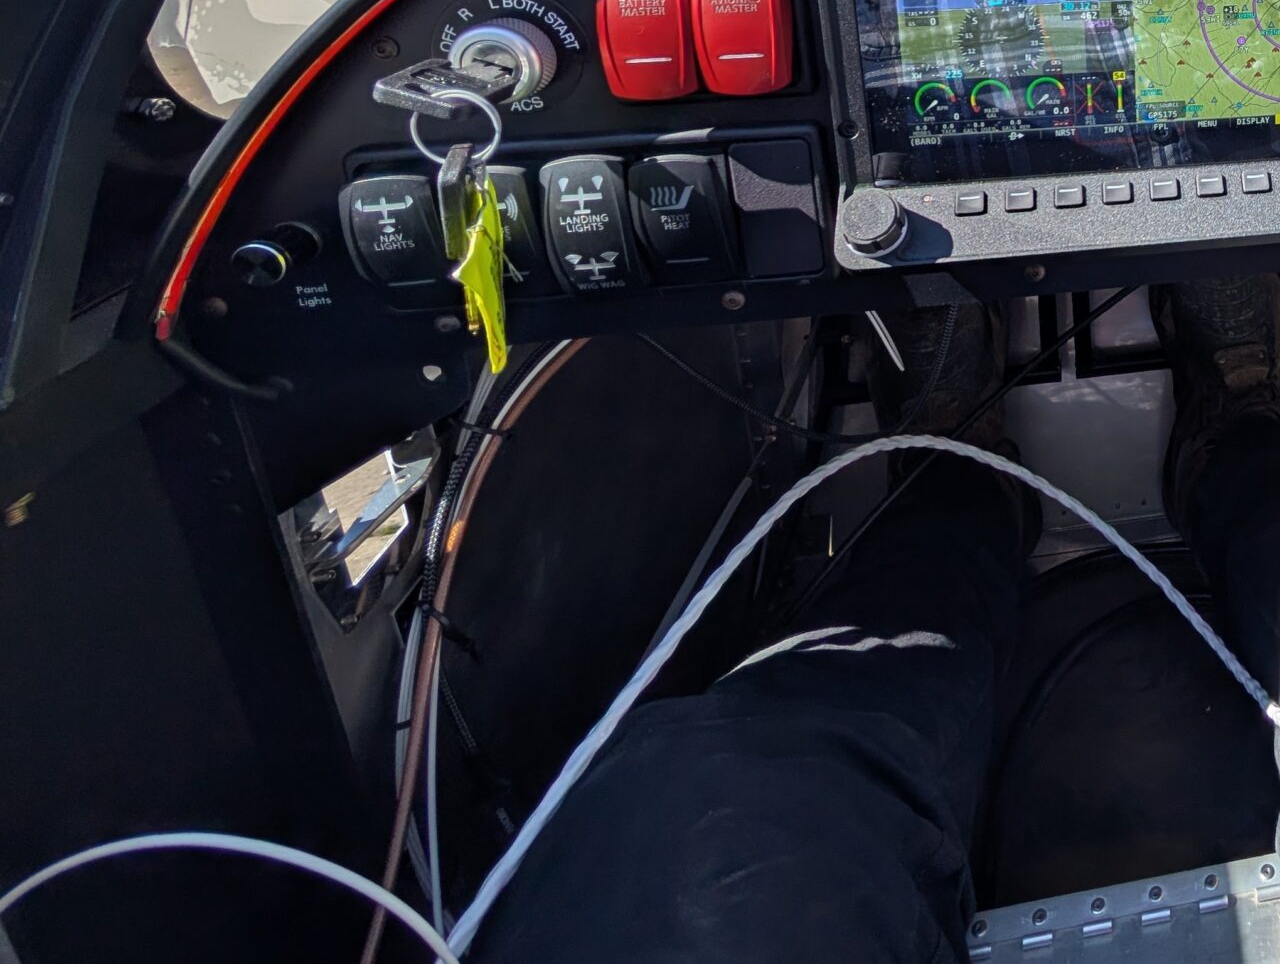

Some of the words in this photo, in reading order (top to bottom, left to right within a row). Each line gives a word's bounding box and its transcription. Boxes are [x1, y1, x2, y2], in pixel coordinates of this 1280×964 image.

[621, 7, 666, 17] MASTER
[714, 3, 758, 14] MASTER
[439, 24, 457, 53] OFF
[457, 7, 474, 22] R
[544, 11, 581, 51] START
[510, 96, 544, 112] ACS
[1053, 106, 1070, 115] 0.0
[1197, 120, 1218, 128] MENU
[1236, 117, 1270, 125] DISPLAY
[1103, 126, 1124, 134] INFO
[1153, 123, 1169, 131] FPL
[1055, 128, 1076, 137] NRST
[910, 136, 941, 147] (BARO)
[559, 213, 609, 226] LANDING
[660, 213, 691, 223] PITOT
[566, 222, 605, 233] LIGHTS
[664, 221, 691, 230] HEAT
[379, 233, 404, 243] NAV
[373, 239, 416, 252] LIGHTS
[295, 283, 329, 294] Panel
[577, 282, 599, 291] WIG
[602, 279, 627, 289] WAG
[298, 296, 332, 308] Lights
